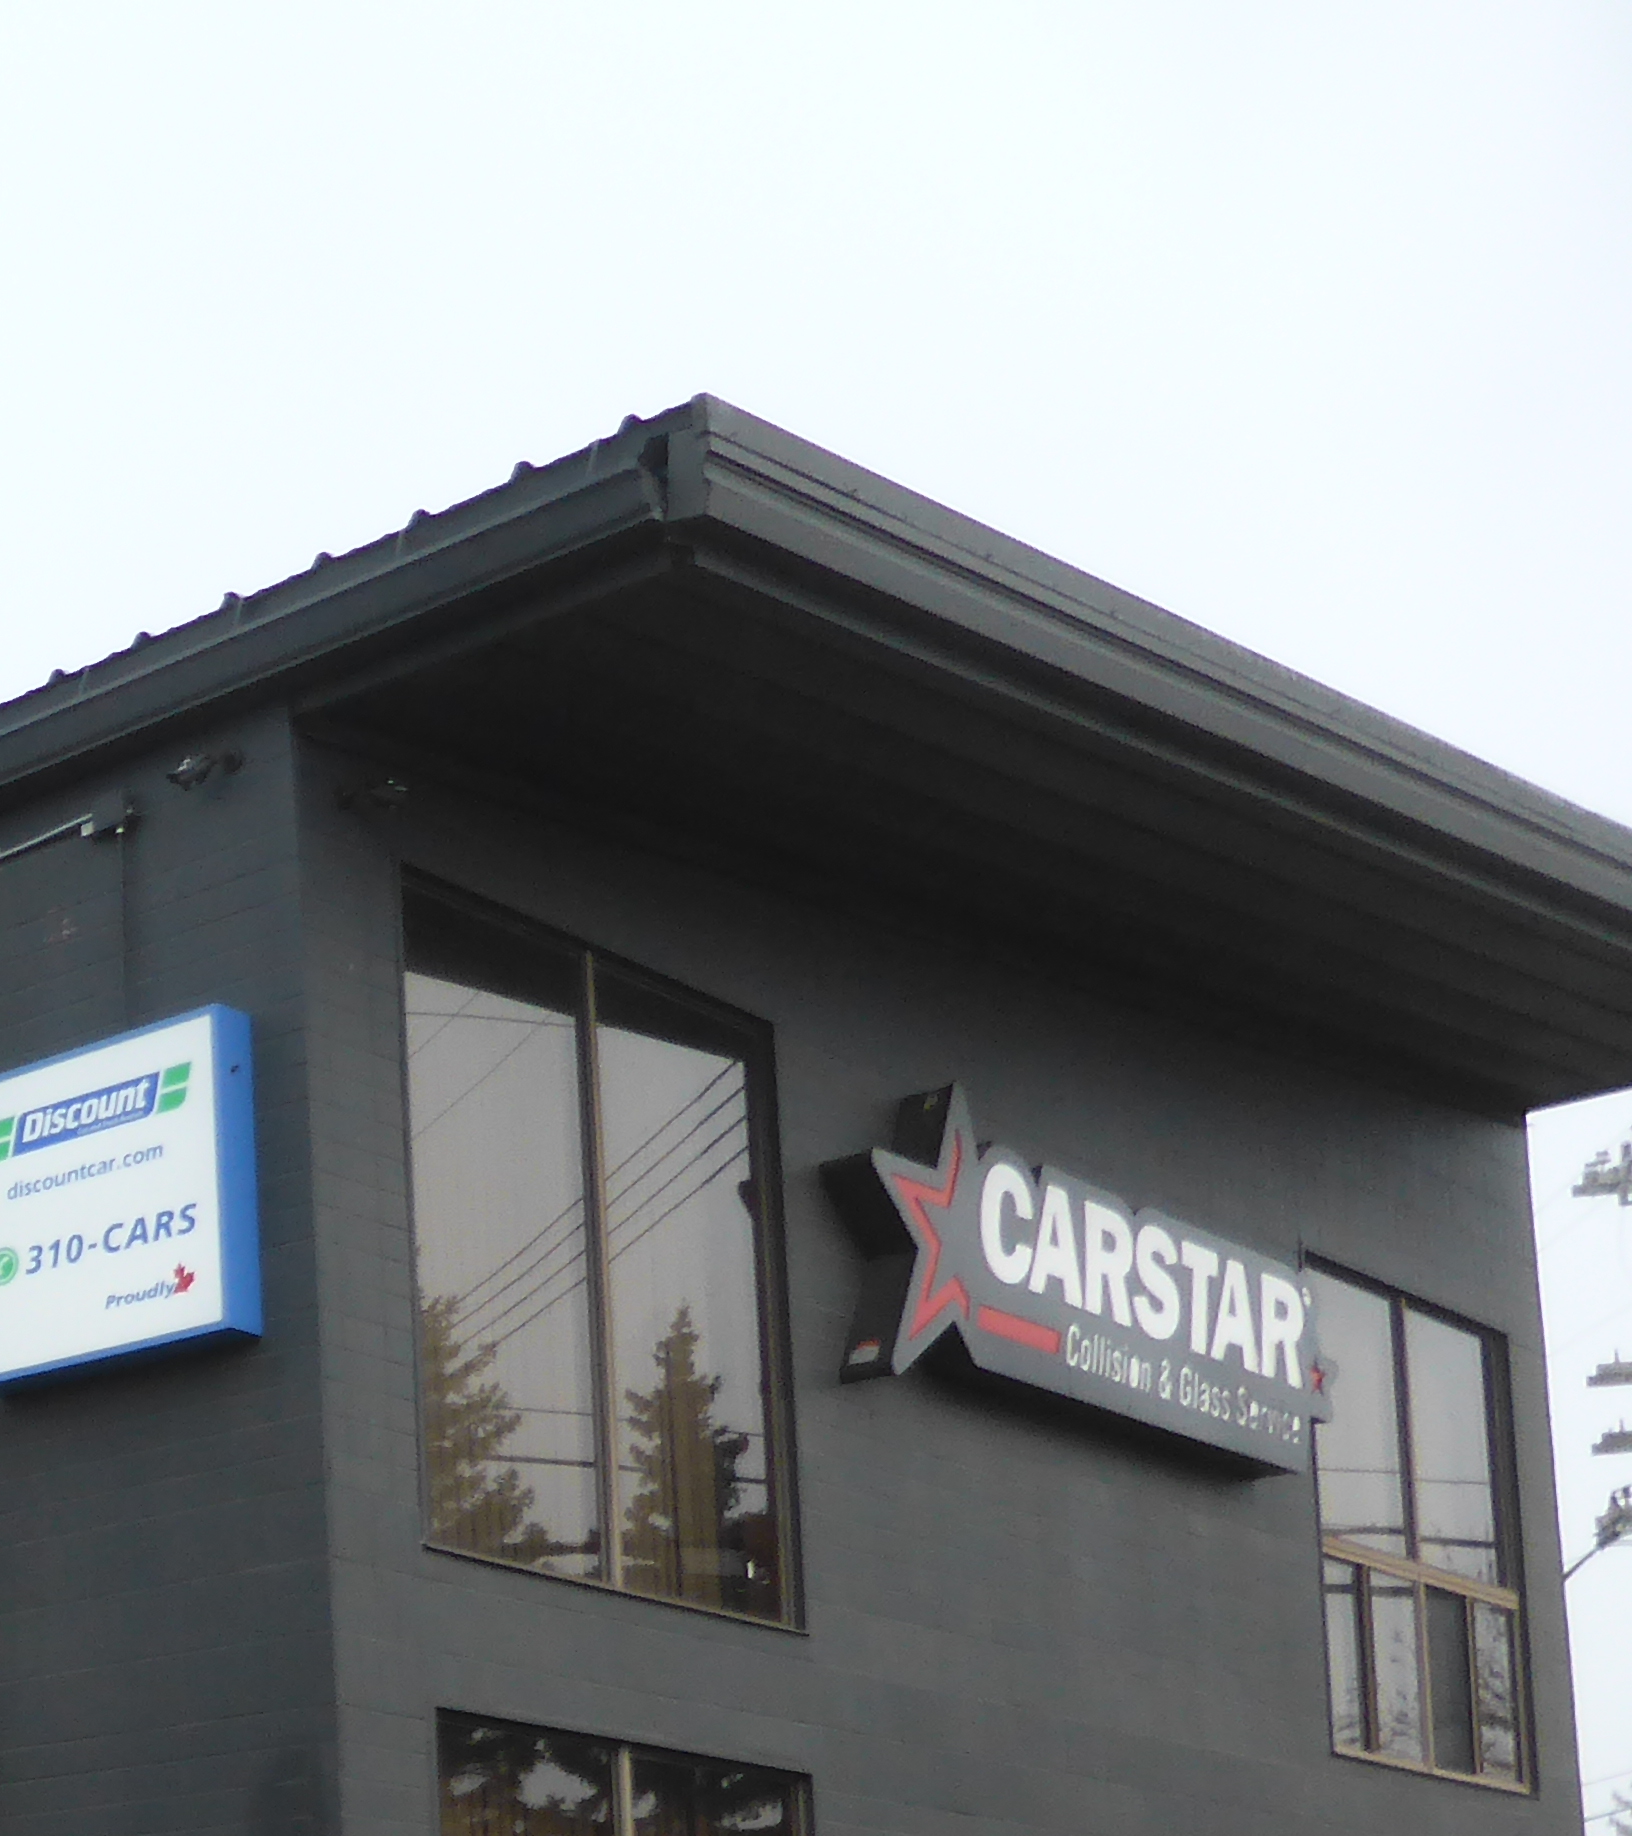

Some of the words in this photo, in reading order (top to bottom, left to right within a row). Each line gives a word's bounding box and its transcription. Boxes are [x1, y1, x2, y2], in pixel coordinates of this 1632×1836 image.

[22, 1078, 151, 1143] Discount
[7, 1144, 163, 1200] discountcar.com
[25, 1203, 197, 1275] 310-CARS
[105, 1281, 175, 1309] Proudly
[980, 1162, 1306, 1389] CARSTAR
[1065, 1323, 1152, 1393] Collision
[1158, 1358, 1172, 1400] &
[1179, 1365, 1232, 1421] Glass
